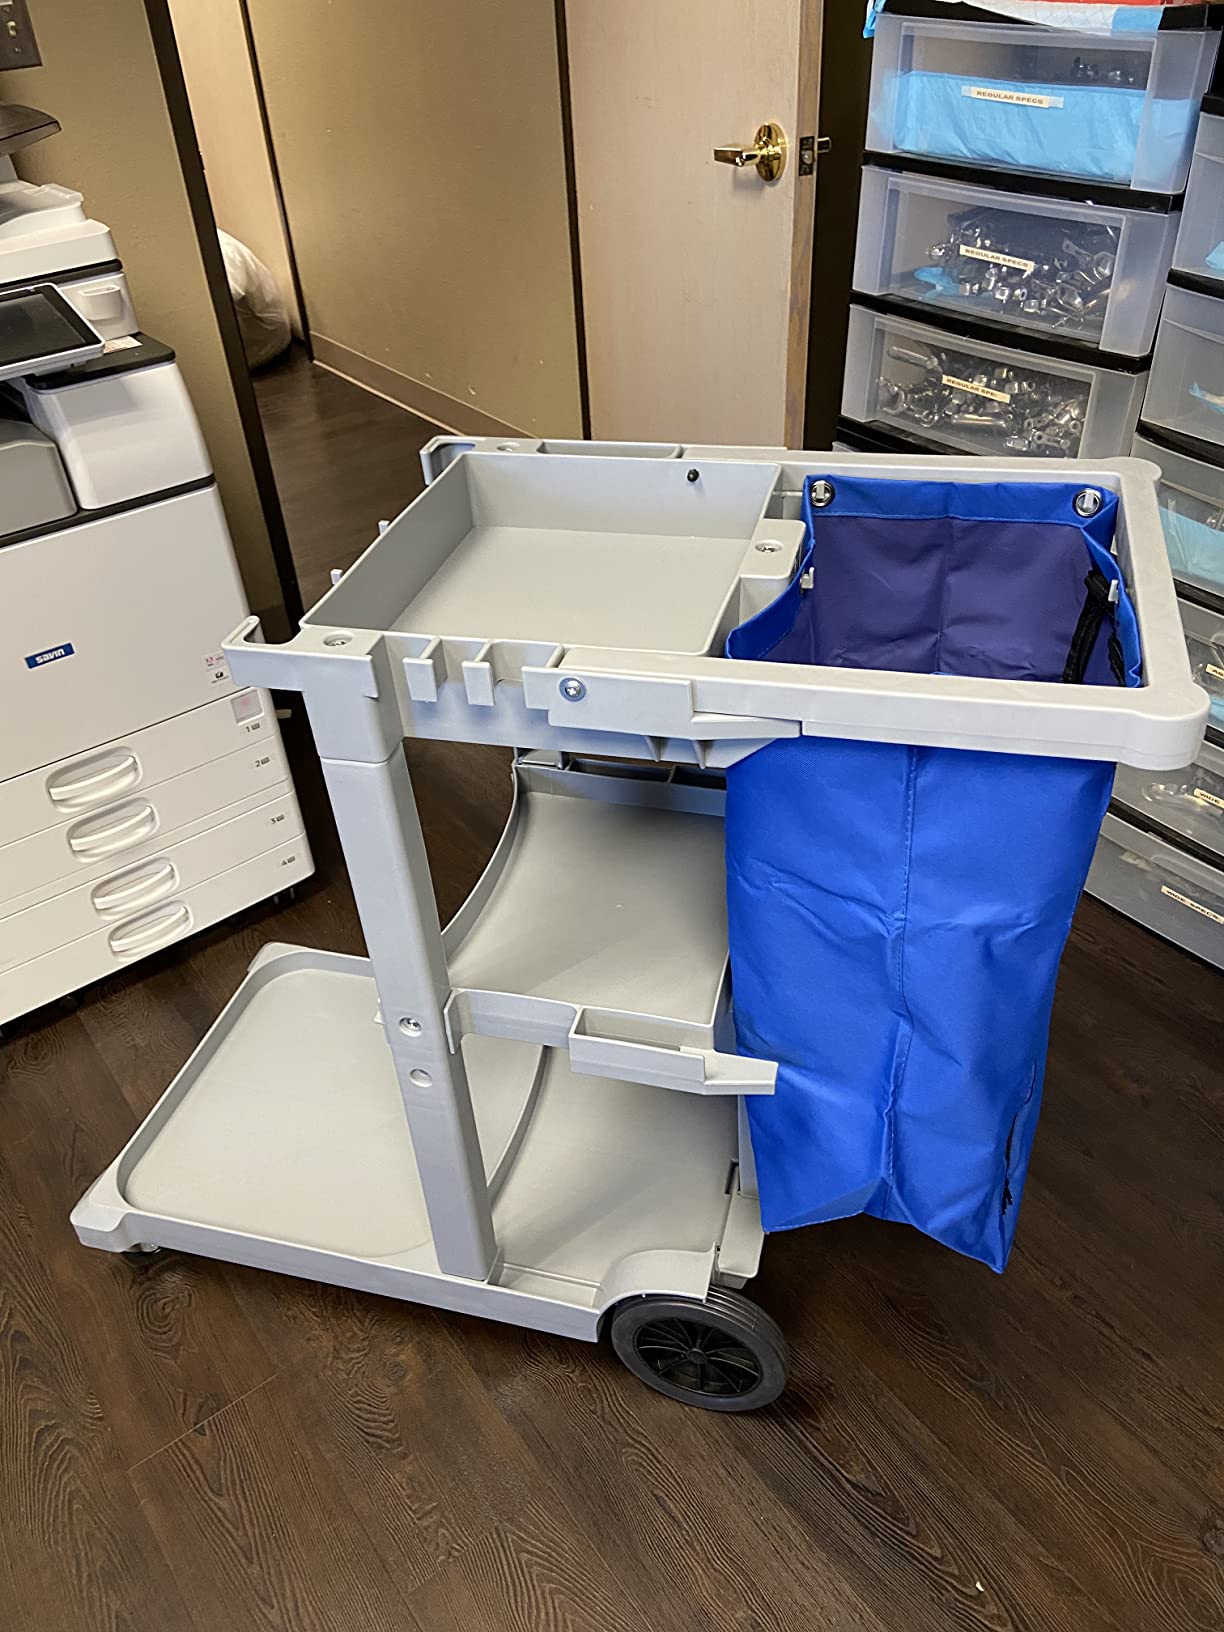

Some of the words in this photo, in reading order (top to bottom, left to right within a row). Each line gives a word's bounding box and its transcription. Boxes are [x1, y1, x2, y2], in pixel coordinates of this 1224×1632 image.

[976, 90, 1014, 101] REGULAR
[1015, 95, 1043, 105] SPECS
[964, 249, 1001, 262] REGULAR
[1001, 257, 1029, 268] SPECS
[946, 378, 980, 392] REGULAR
[35, 648, 65, 664] savin
